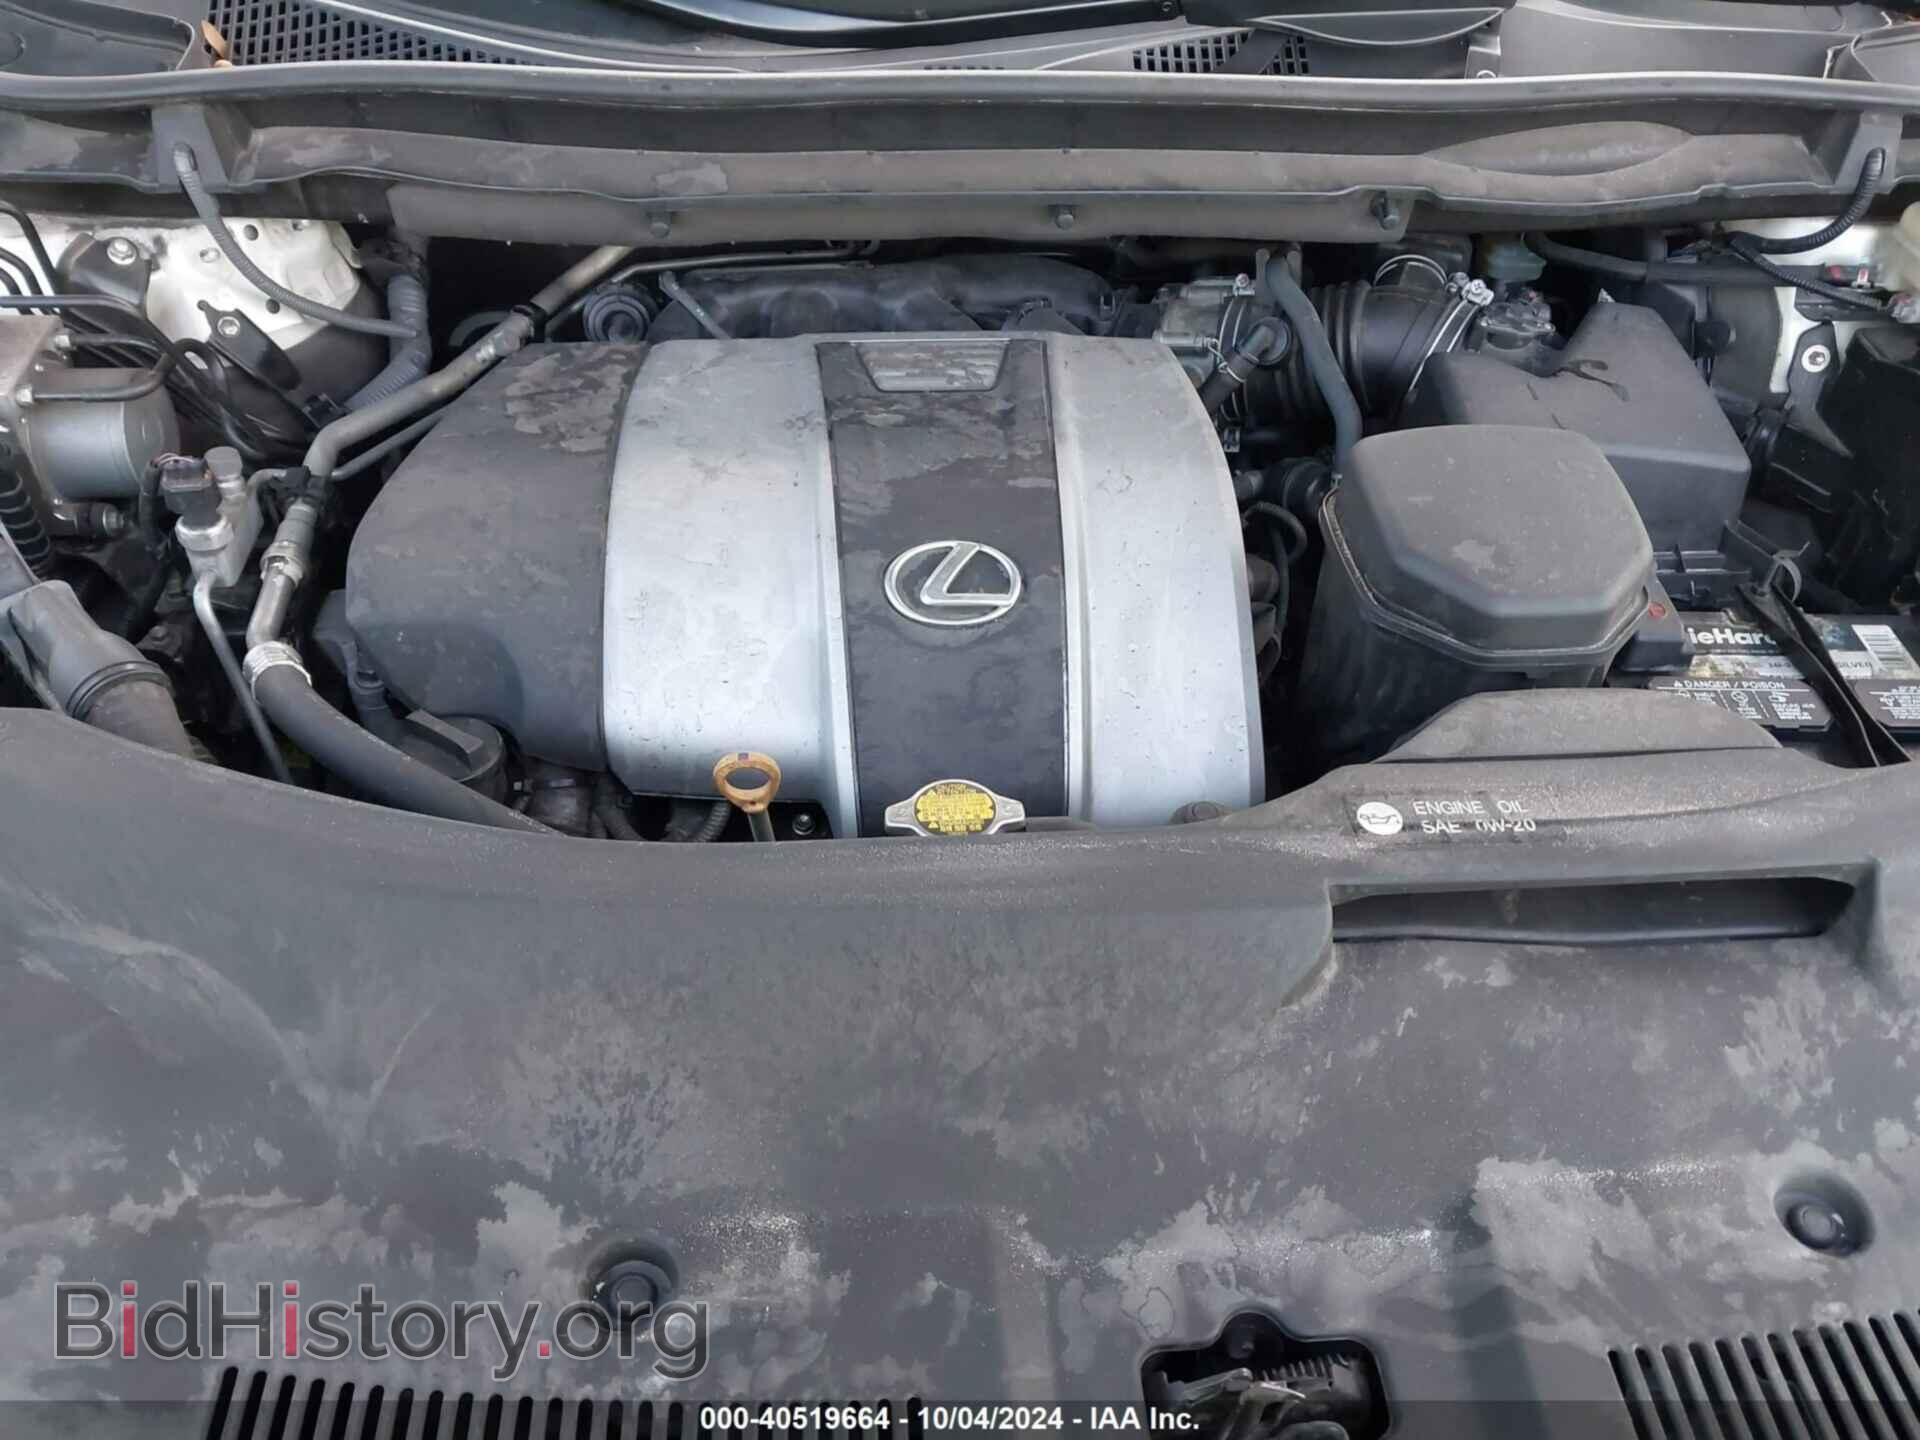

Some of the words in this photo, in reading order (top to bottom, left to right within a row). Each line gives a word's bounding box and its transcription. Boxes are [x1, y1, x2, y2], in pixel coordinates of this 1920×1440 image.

[1687, 627, 1777, 645] ieHar
[1412, 800, 1484, 816] ENGINE
[1496, 799, 1529, 814] OIL
[1422, 819, 1463, 834] SAE
